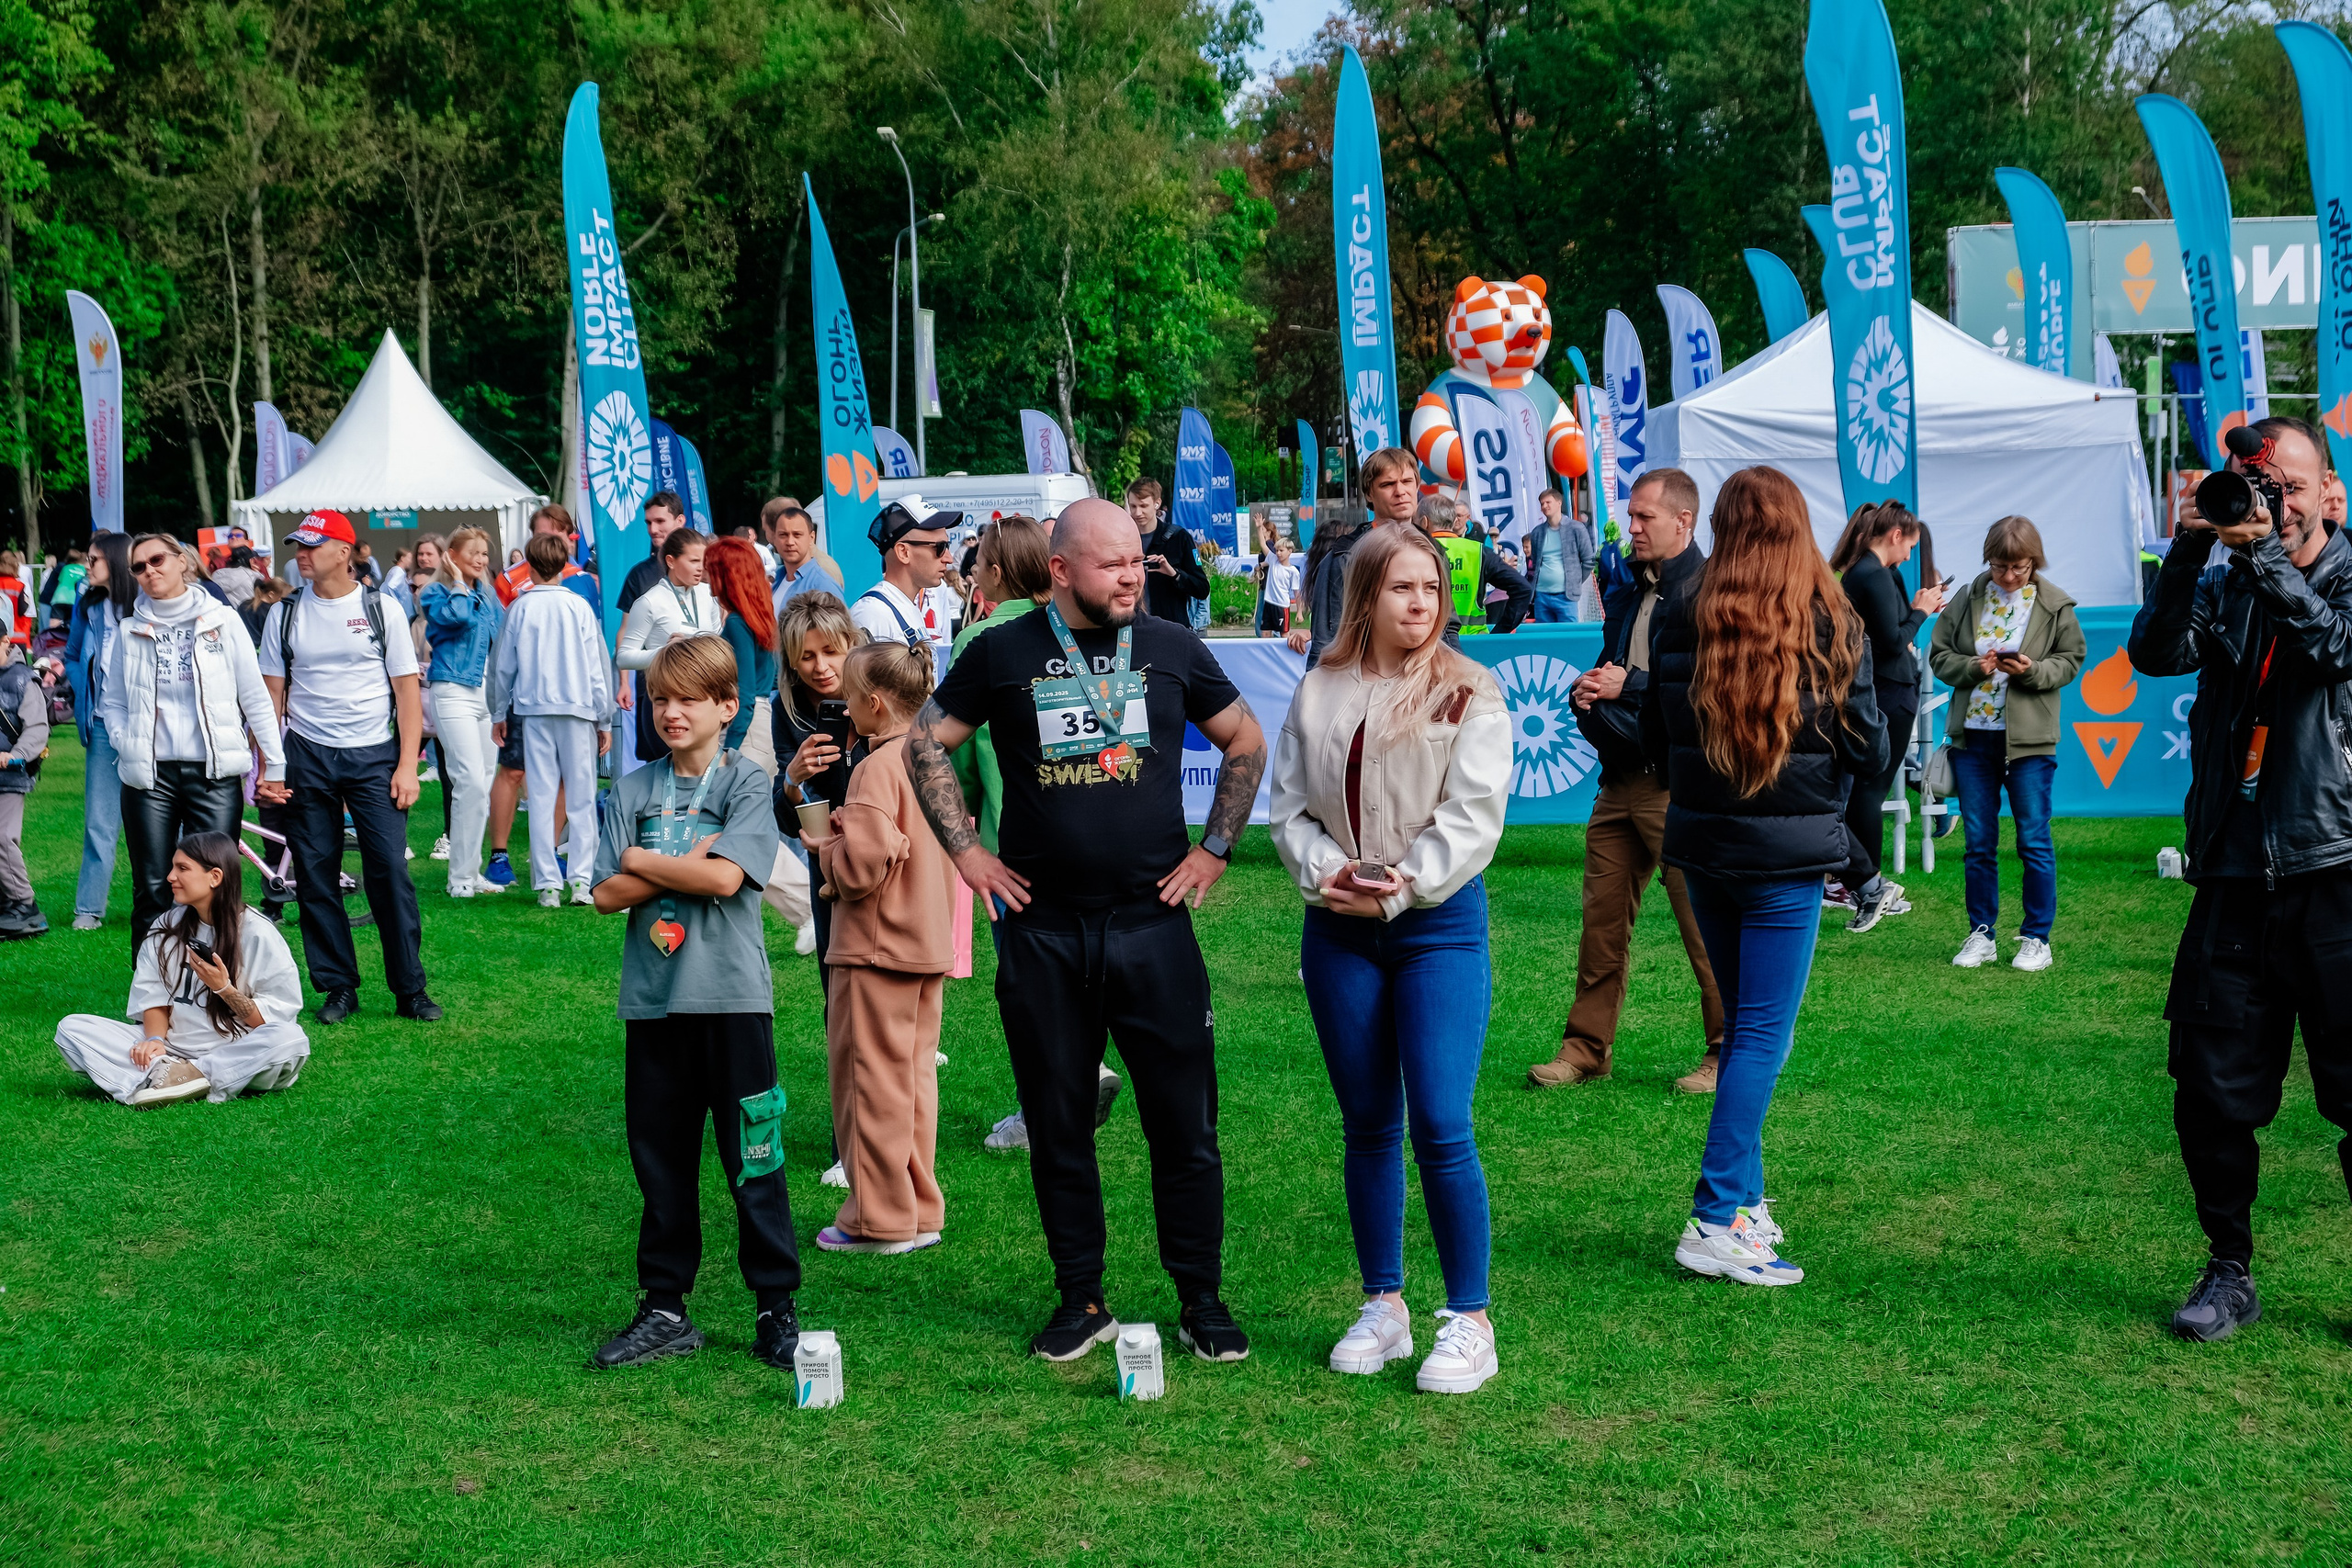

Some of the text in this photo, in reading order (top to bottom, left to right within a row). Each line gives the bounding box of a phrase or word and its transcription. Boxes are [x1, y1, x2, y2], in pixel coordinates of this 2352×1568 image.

[579, 231, 610, 367] NOBLE
[592, 207, 626, 368] IMPACT
[828, 314, 851, 428] ОГОНЬ
[839, 308, 868, 437] ЖИЗНИ
[1037, 690, 1069, 698] 14.09.2025
[1037, 759, 1141, 784] SWET
